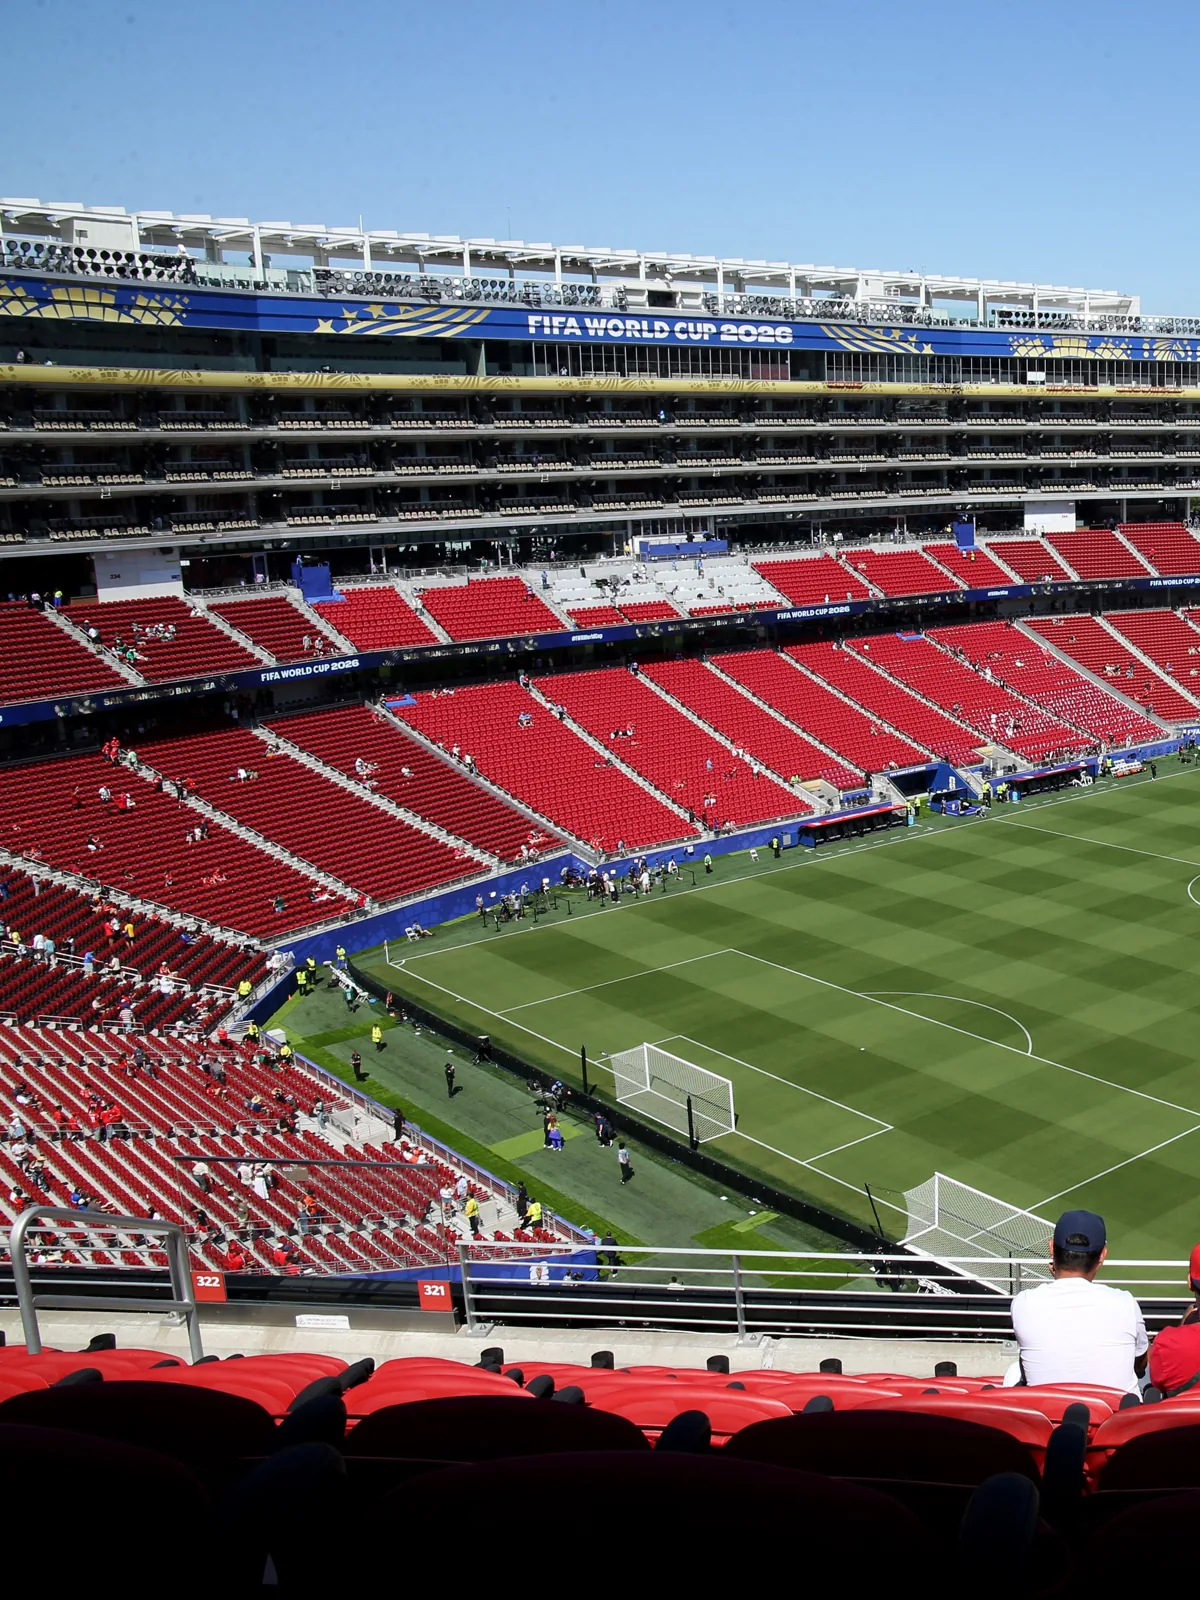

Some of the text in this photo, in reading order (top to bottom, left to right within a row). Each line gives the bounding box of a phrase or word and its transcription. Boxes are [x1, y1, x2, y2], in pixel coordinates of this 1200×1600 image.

[527, 314, 794, 344] FIFA WORLD CUP 2026
[776, 612, 791, 620] FIFA
[791, 609, 815, 618] WORLD
[828, 606, 851, 614] 2026
[261, 659, 360, 682] FIFA WORLD CUP 2026
[196, 1276, 221, 1287] 322
[423, 1285, 445, 1296] 321
